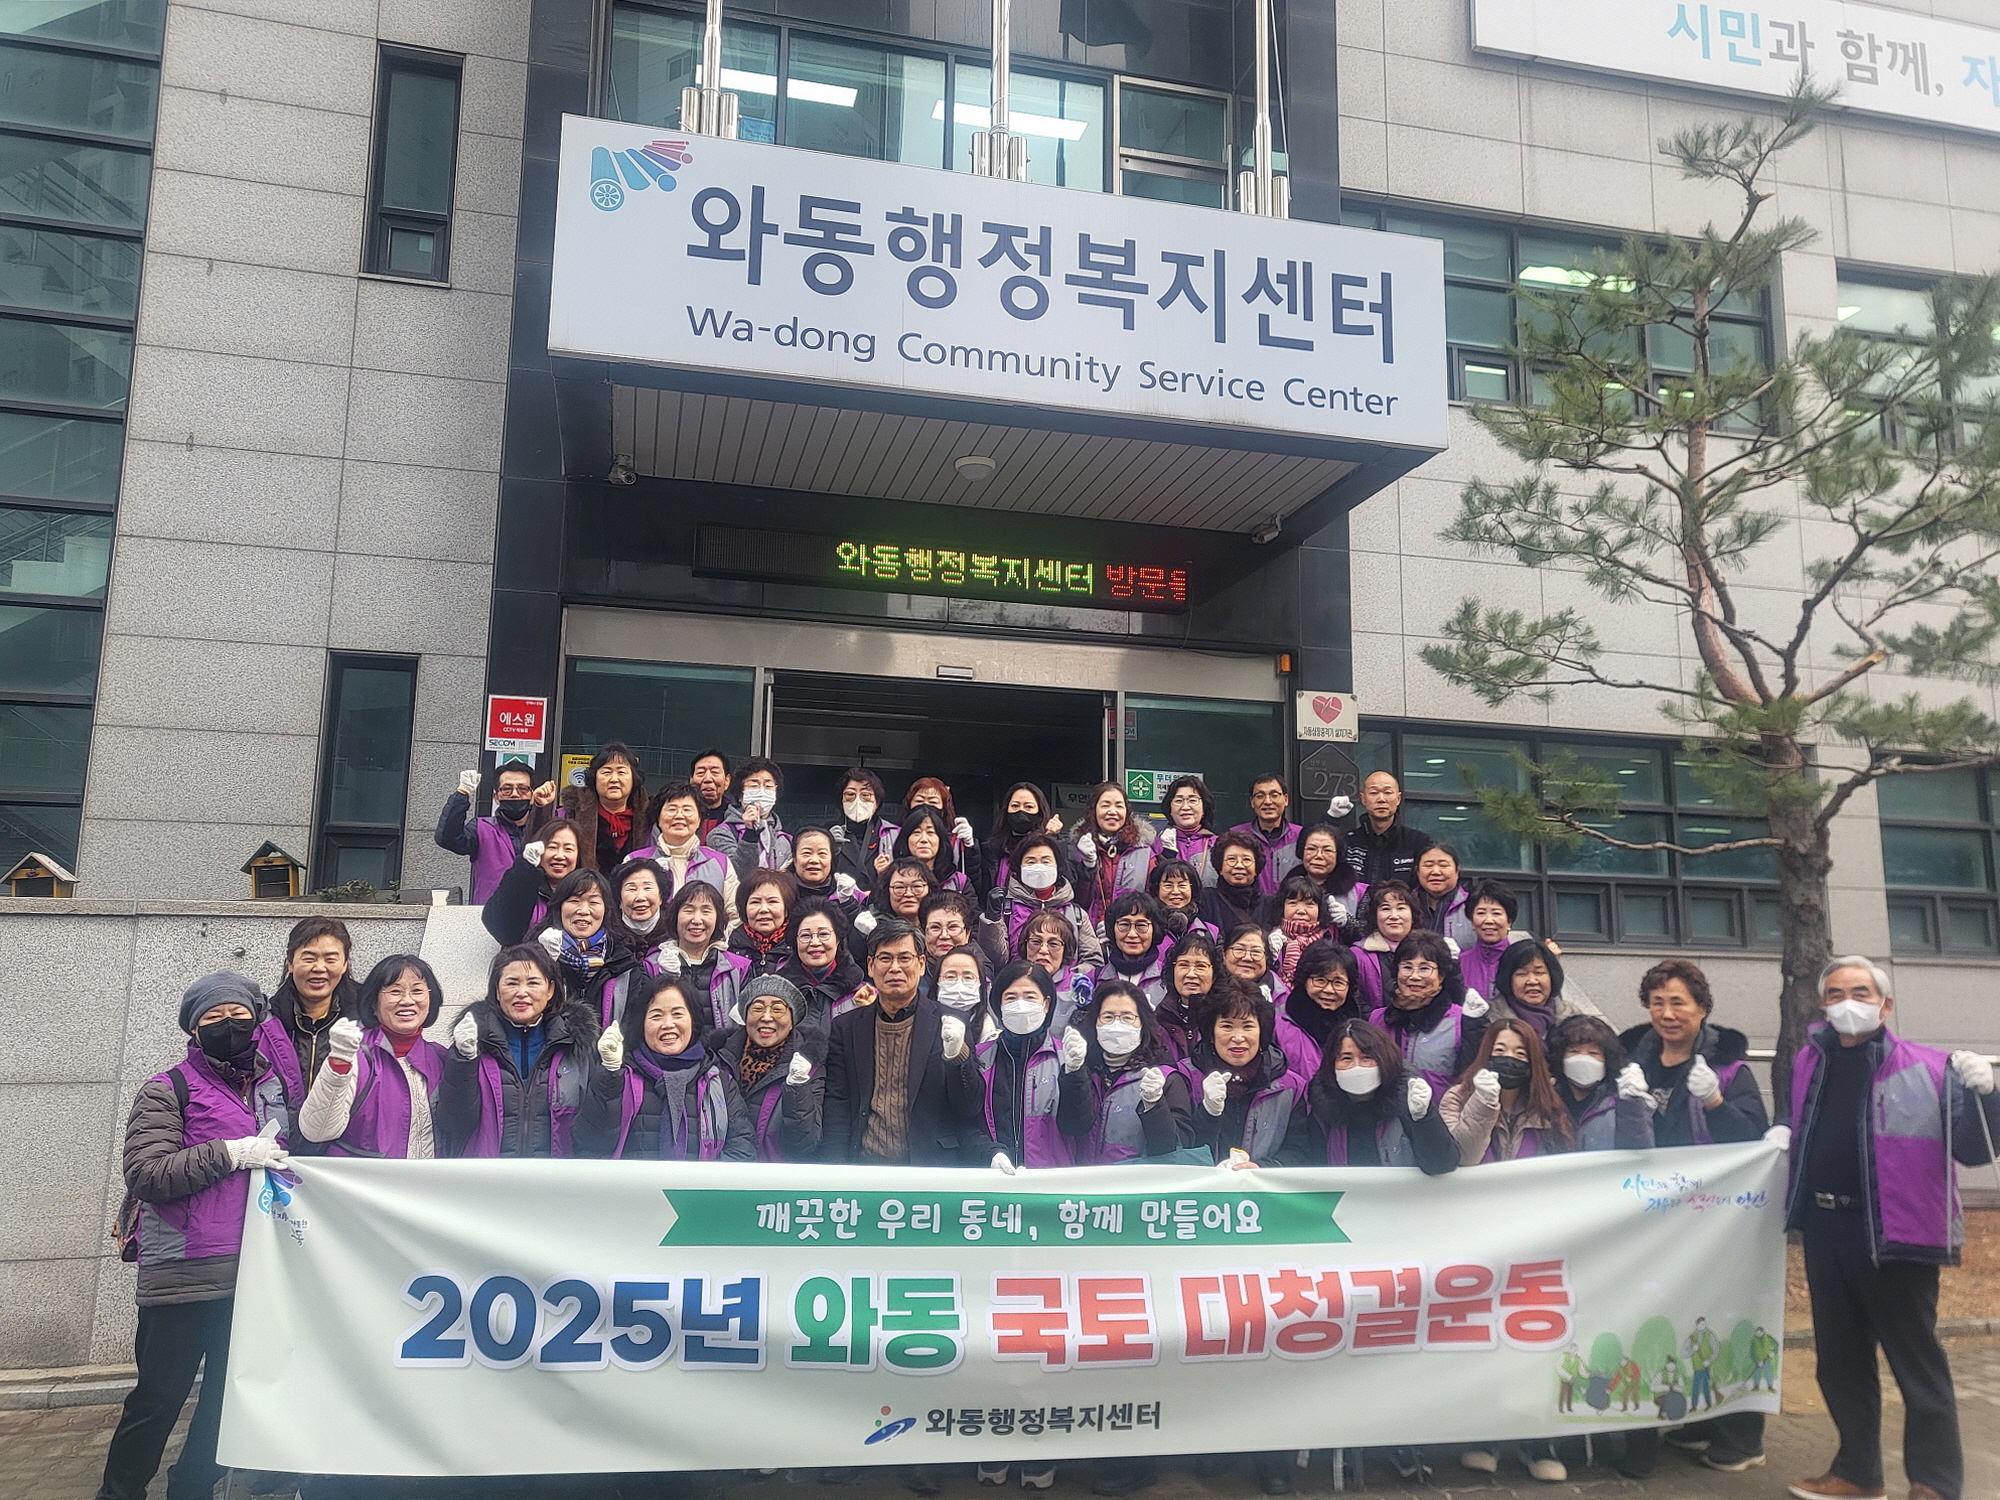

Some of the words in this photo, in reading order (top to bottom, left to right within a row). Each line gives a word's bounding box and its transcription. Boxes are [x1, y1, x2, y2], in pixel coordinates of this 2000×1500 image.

[1667, 3, 1816, 74] 시민과
[1836, 29, 1945, 97] 함께,
[686, 184, 1394, 365] 와동행정복지센터
[686, 304, 877, 363] Wa-dong
[897, 331, 1122, 392] Community
[1138, 360, 1266, 402] Service
[1282, 377, 1399, 417] Center
[835, 540, 1094, 596] 와동행정복지센터
[499, 711, 536, 727] 에스원
[1109, 727, 1136, 735] SOM
[488, 739, 516, 747] SECOM
[1313, 771, 1357, 797] 273
[757, 1198, 862, 1241] 깨끗한
[877, 1198, 941, 1240] 우리
[957, 1199, 1039, 1242] 동네,
[1058, 1199, 1124, 1240] 함께
[1139, 1198, 1263, 1241] 만들어요
[399, 1273, 761, 1365] 2025년
[789, 1275, 961, 1371] 와동
[990, 1275, 1156, 1366] 국토
[1179, 1258, 1572, 1360] 대청결운동
[925, 1402, 1162, 1437] 와동행정복지센터
